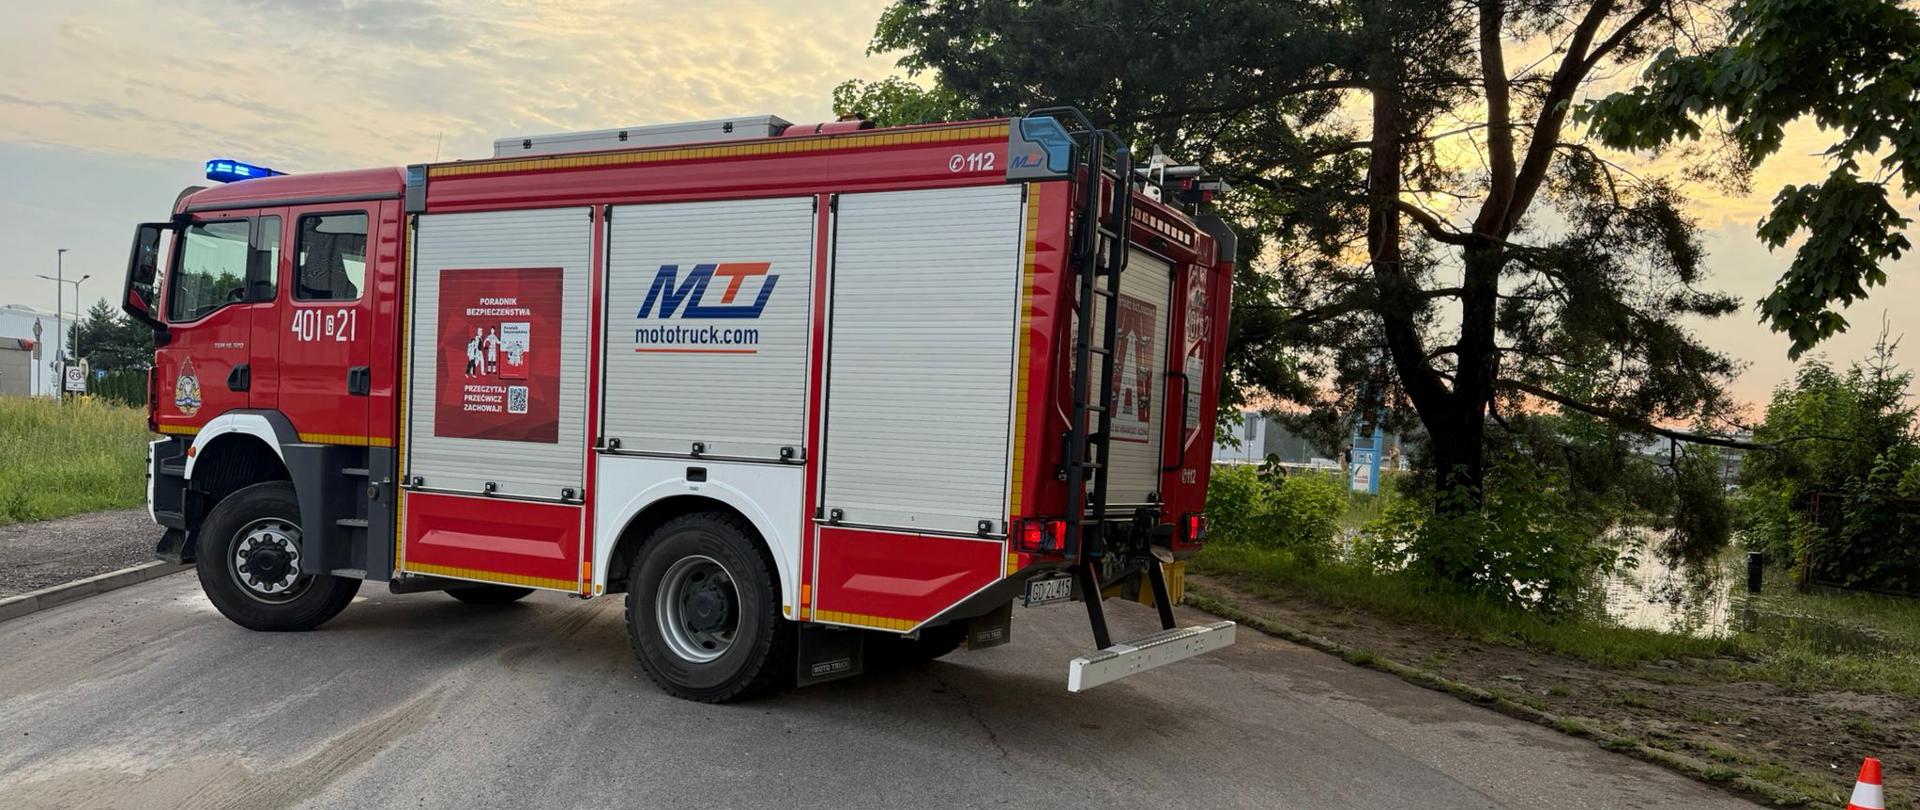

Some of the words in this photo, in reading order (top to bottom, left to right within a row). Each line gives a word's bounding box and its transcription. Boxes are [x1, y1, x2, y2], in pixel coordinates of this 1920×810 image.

[967, 152, 995, 171] 112
[480, 297, 517, 305] PORADNIK
[466, 306, 531, 316] BEZPIECZEŃSTWA
[292, 309, 321, 342] 401
[336, 309, 356, 342] 21
[635, 325, 758, 344] mototruck.com
[464, 385, 507, 393] PRZECZYTAJ
[464, 394, 502, 403] PRZEĆWICZ
[464, 404, 502, 412] ZACHOWAJ!
